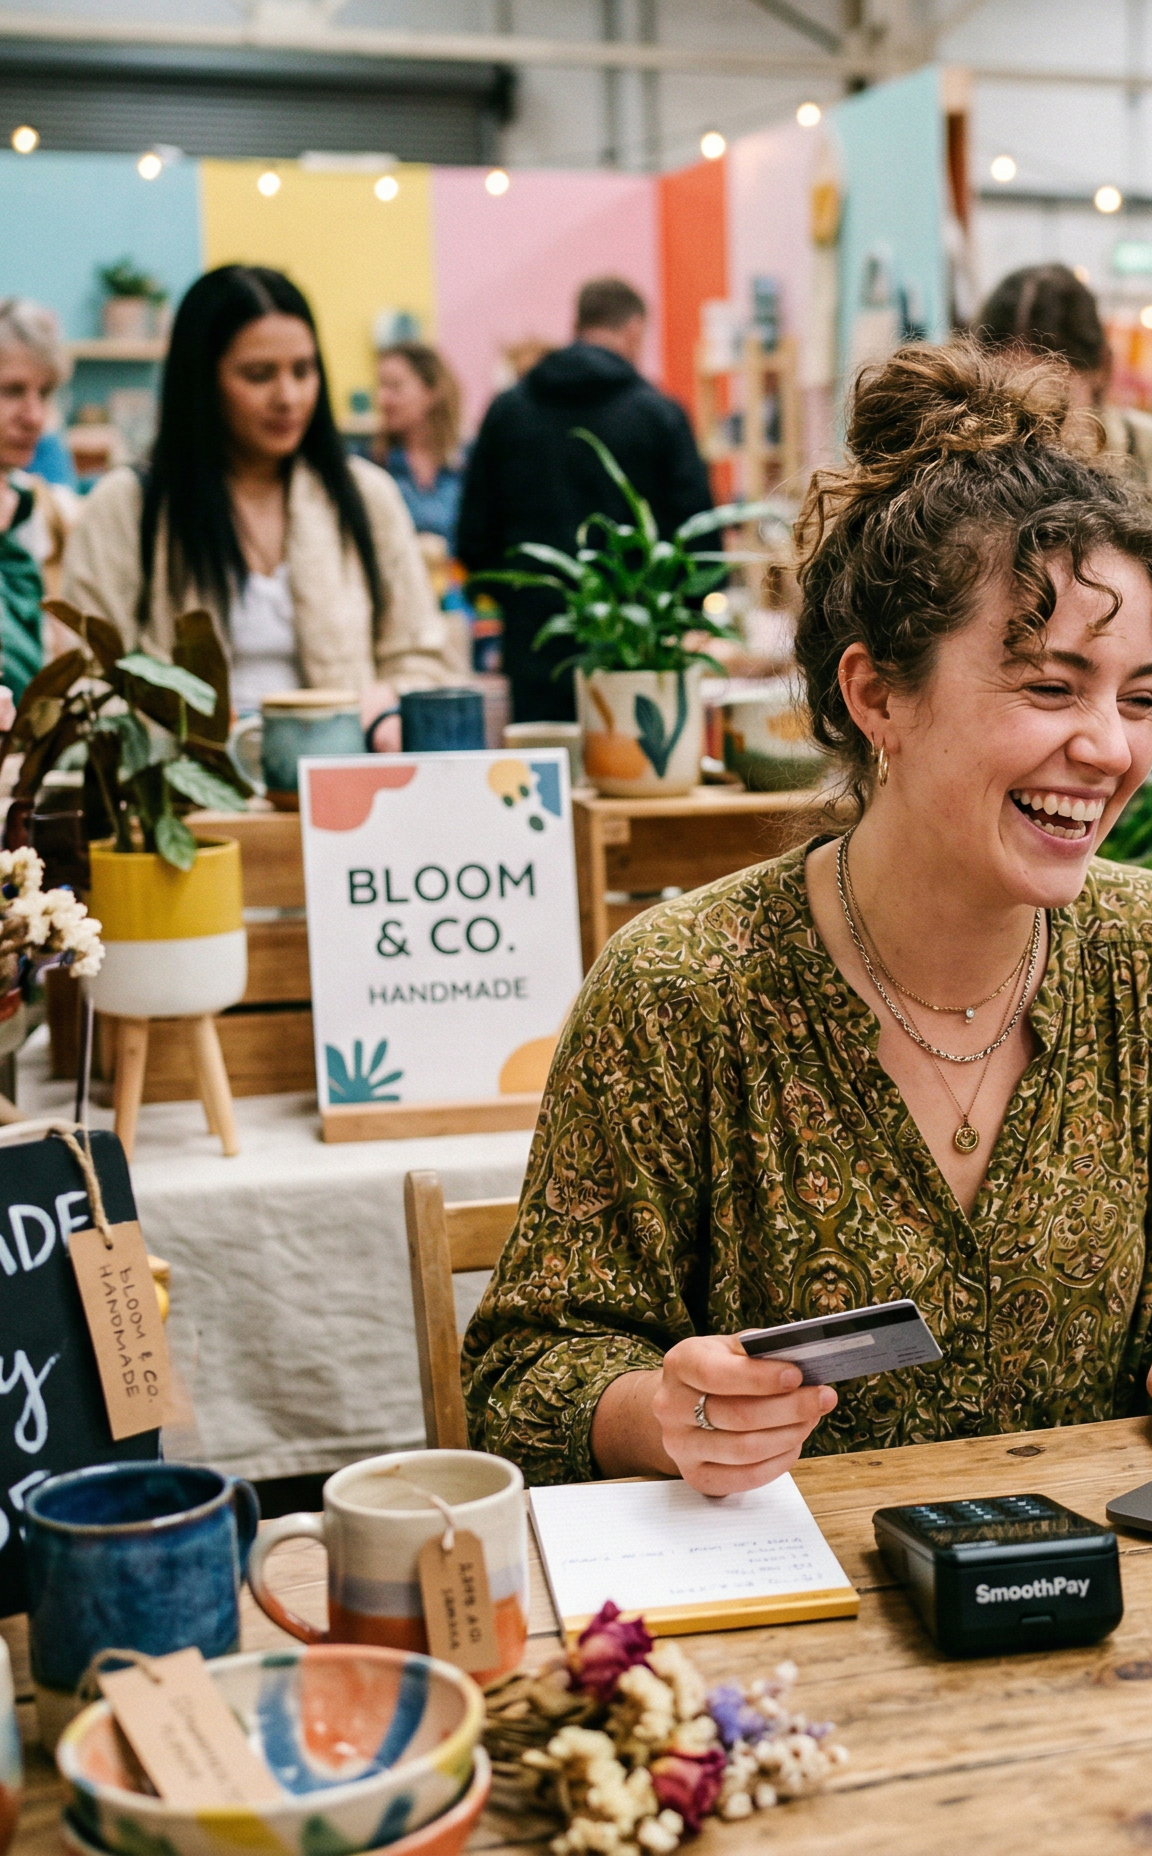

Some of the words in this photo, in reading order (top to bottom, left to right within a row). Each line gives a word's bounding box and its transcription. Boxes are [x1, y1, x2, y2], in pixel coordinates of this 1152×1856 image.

[348, 862, 536, 906] BLOOM
[376, 920, 411, 958] &
[430, 917, 516, 956] CO.
[368, 977, 529, 1006] HANDMADE
[0, 1190, 88, 1276] DE
[99, 1264, 139, 1398] HANDMADE
[975, 1576, 1091, 1604] SmoothPay
